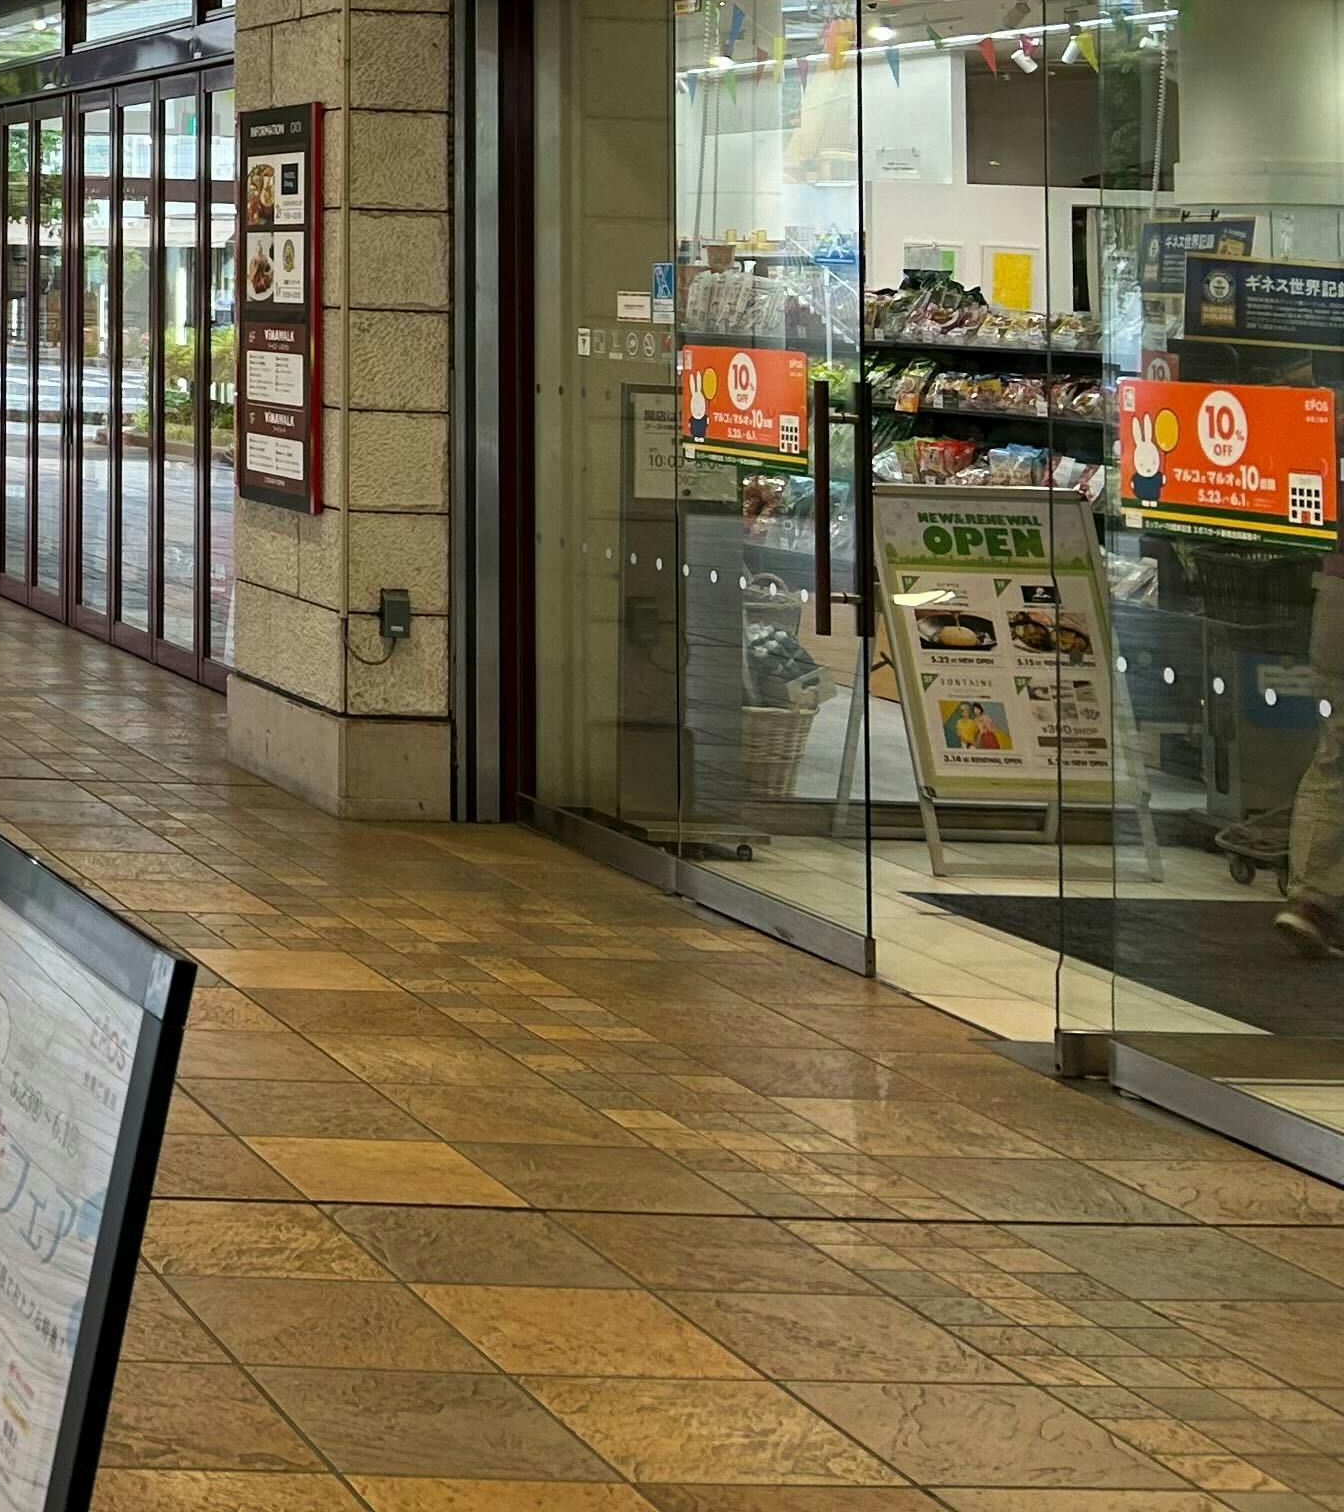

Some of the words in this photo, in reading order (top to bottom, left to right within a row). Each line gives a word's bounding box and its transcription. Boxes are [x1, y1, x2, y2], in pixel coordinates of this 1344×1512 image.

[249, 123, 285, 137] INFORMATION
[736, 393, 749, 403] OFF
[1304, 398, 1329, 412] EPOS
[1213, 443, 1233, 457] OFF
[917, 512, 1042, 527] NEW&RENEWAL
[922, 525, 1046, 558] OPEN
[1041, 724, 1072, 735] ¥30
